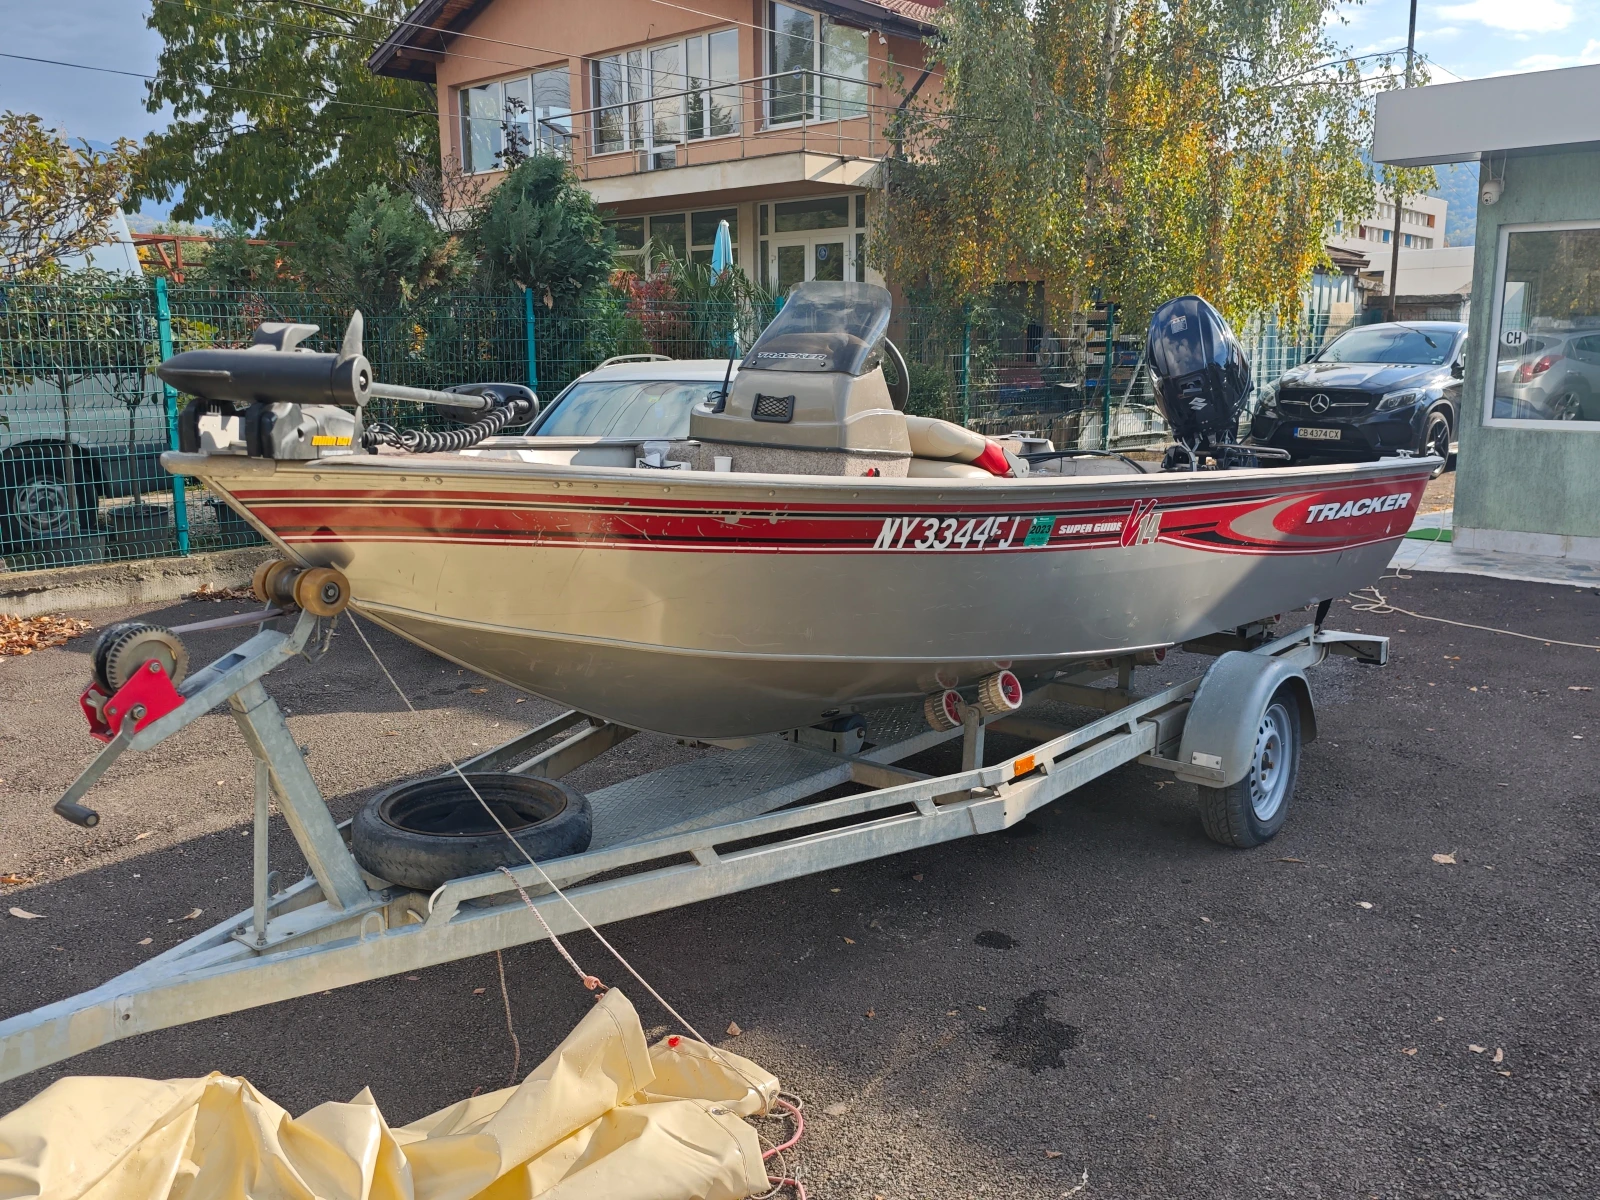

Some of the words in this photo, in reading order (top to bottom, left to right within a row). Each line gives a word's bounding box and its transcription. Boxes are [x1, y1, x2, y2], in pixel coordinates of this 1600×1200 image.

[1506, 331, 1522, 344] CH
[757, 351, 828, 360] TRACKER
[1305, 492, 1412, 524] TRACKER
[1029, 524, 1052, 535] 2023
[1058, 523, 1093, 535] SUPER
[1093, 521, 1122, 533] GUIDE
